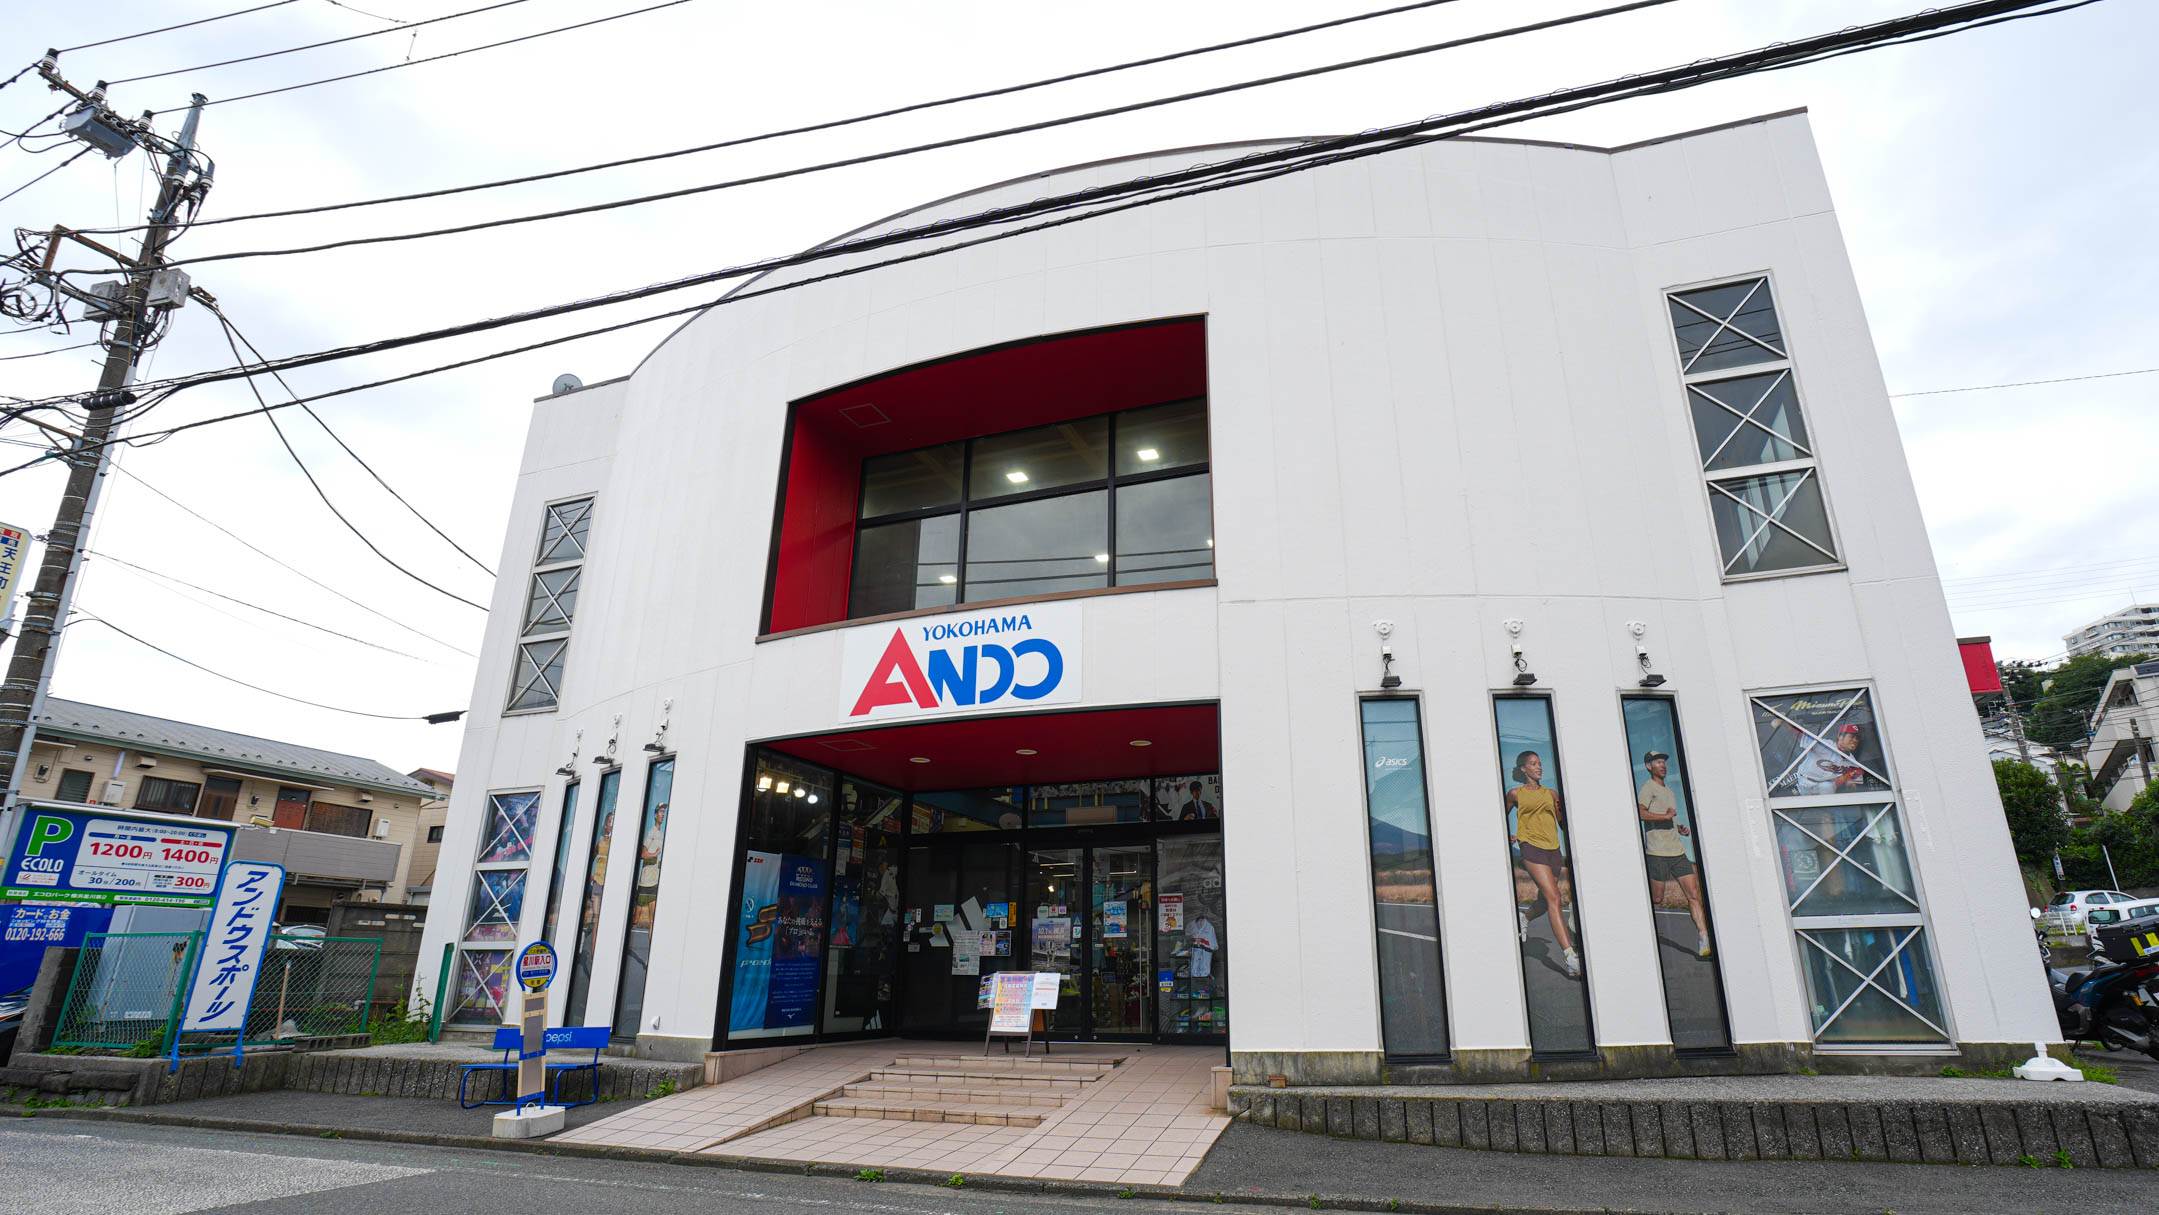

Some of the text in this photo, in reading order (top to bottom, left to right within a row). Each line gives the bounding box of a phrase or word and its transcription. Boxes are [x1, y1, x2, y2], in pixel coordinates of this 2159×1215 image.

[922, 614, 1032, 641] YOKOHAMA
[849, 626, 1064, 717] ANDO
[24, 815, 74, 856] P
[21, 857, 64, 873] ECOLO
[90, 842, 219, 865] 1200円 1400円
[5, 928, 65, 941] 0120-192-666
[198, 870, 270, 1023] アンドウスポーツ
